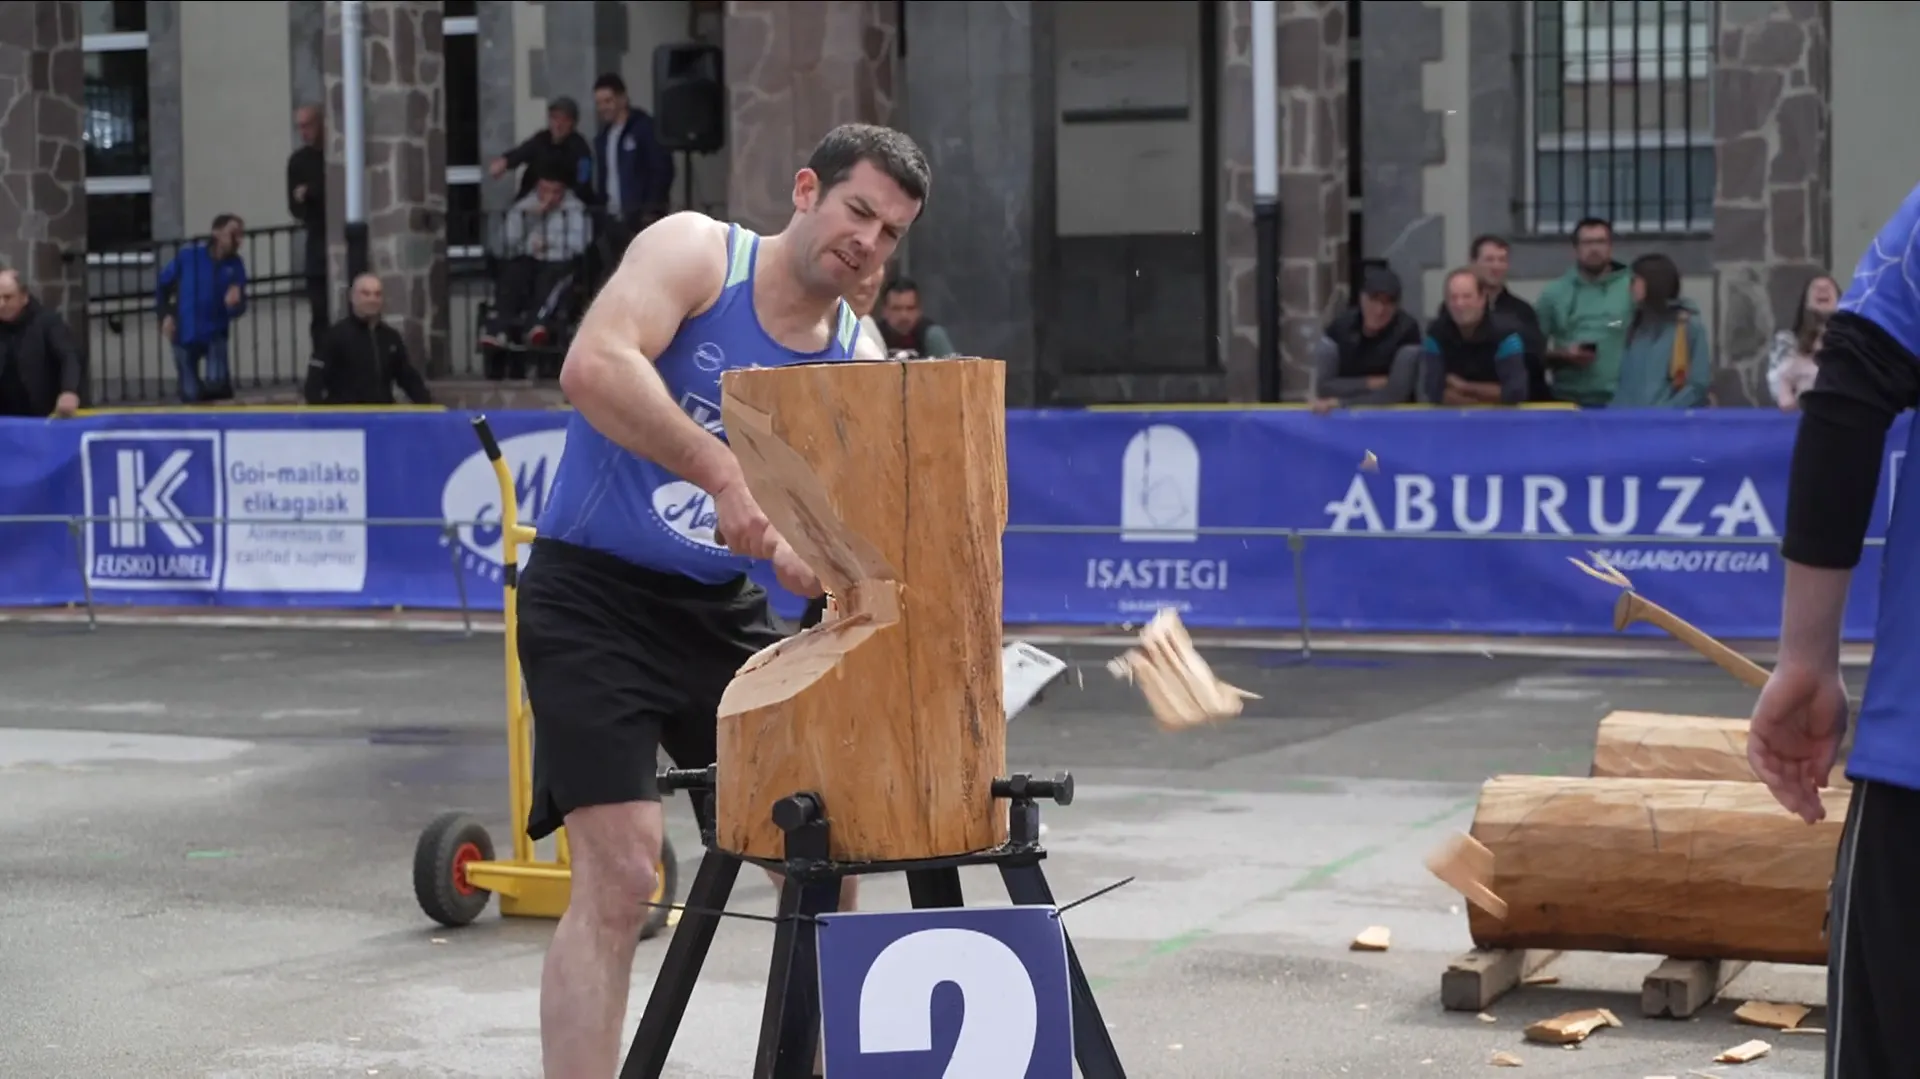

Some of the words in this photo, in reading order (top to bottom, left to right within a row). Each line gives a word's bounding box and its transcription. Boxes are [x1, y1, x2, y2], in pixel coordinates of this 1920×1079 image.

[230, 460, 360, 485] Goi-mailako
[243, 491, 349, 521] elikagaiak
[1324, 474, 1777, 537] ABURUZA
[96, 554, 156, 577] EUSKO
[158, 554, 210, 577] LABEL
[1087, 558, 1229, 590] ISASTEGI
[859, 928, 1038, 1079] 2
